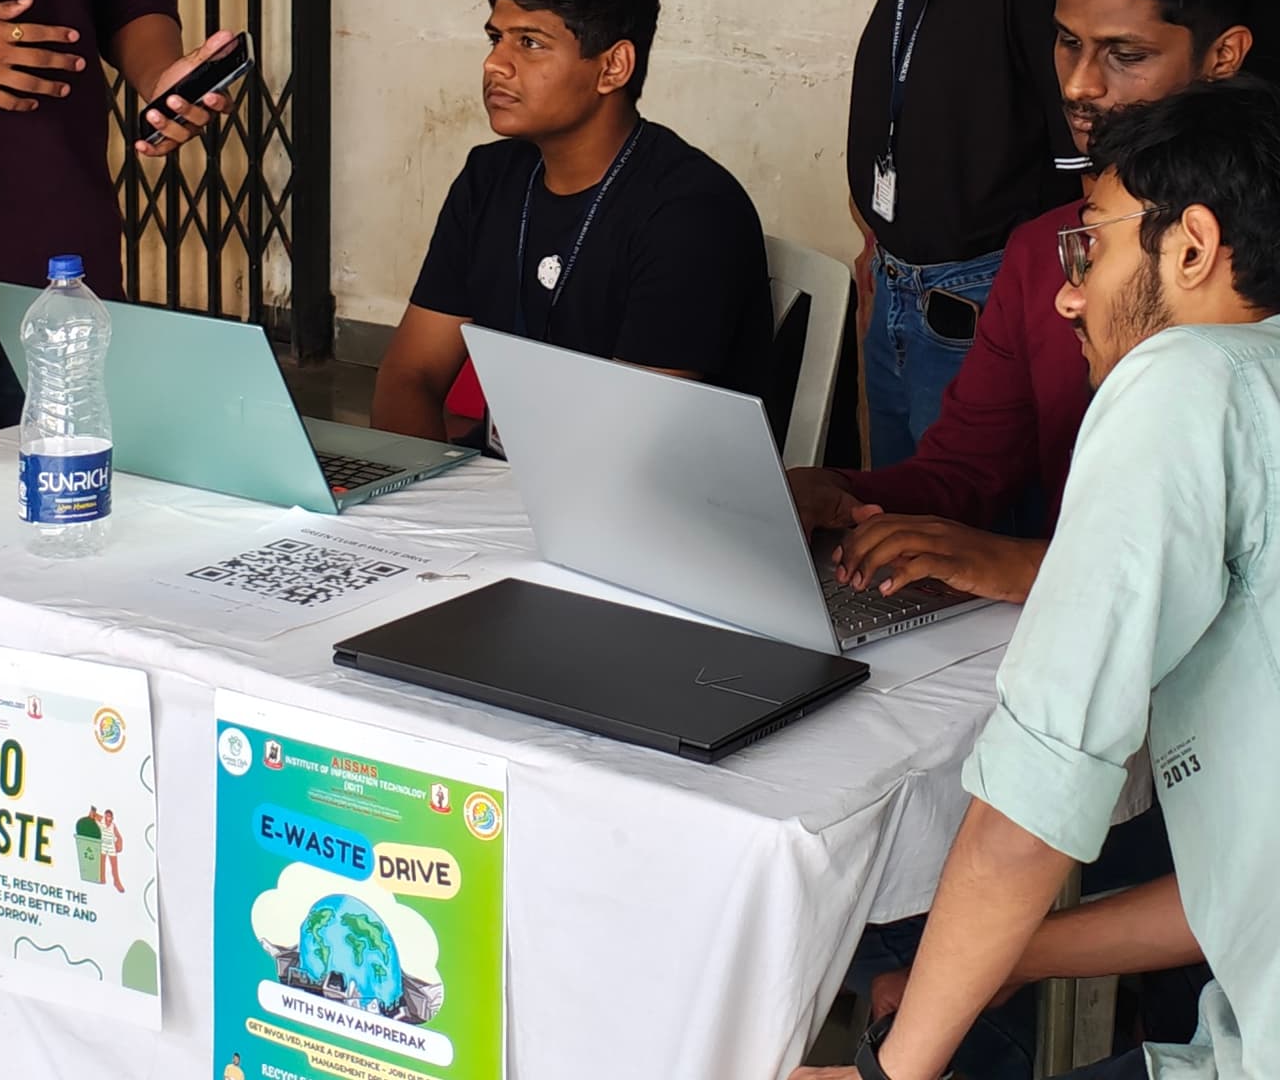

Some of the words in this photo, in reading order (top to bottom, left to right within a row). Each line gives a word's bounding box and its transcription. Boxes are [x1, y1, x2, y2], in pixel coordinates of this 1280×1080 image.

[38, 466, 108, 492] SUNRICH
[331, 755, 378, 778] AISSMS
[1163, 754, 1201, 789] 2013
[260, 814, 367, 870] E-WASTE
[379, 855, 452, 887] DRIVE
[4, 891, 26, 906] FOR
[29, 897, 70, 917] BETTER
[73, 907, 97, 923] AND
[13, 878, 63, 899] RESTORE
[65, 889, 88, 905] THE
[282, 994, 314, 1016] WITH
[316, 1006, 426, 1051] SWAYAMPRERAK
